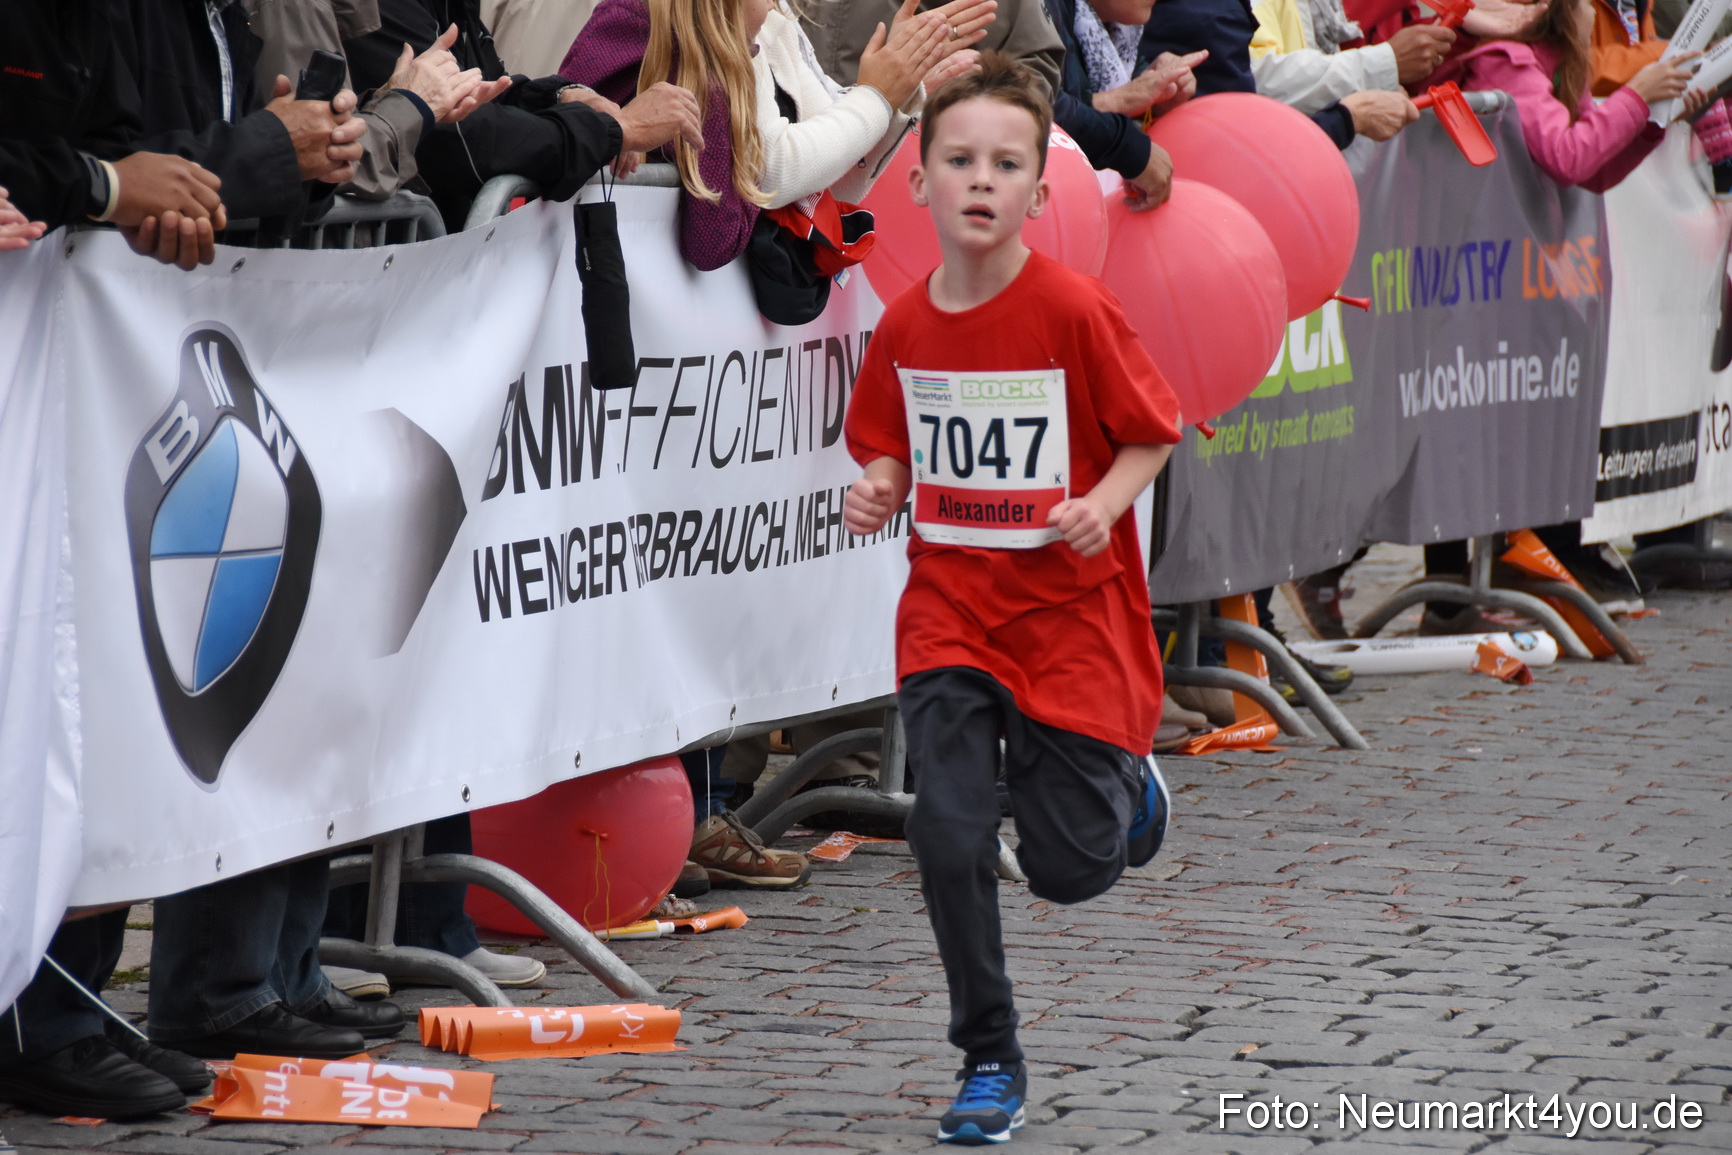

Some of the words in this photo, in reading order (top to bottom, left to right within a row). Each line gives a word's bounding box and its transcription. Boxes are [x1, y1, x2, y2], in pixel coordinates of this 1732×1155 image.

[912, 390, 952, 402] NeuerMarkt
[960, 378, 1047, 400] BOCK
[481, 361, 606, 502] BMW
[1251, 411, 1270, 461] by
[919, 414, 1048, 479] 7047
[1054, 474, 1062, 485] K
[938, 494, 1035, 523] Alexander
